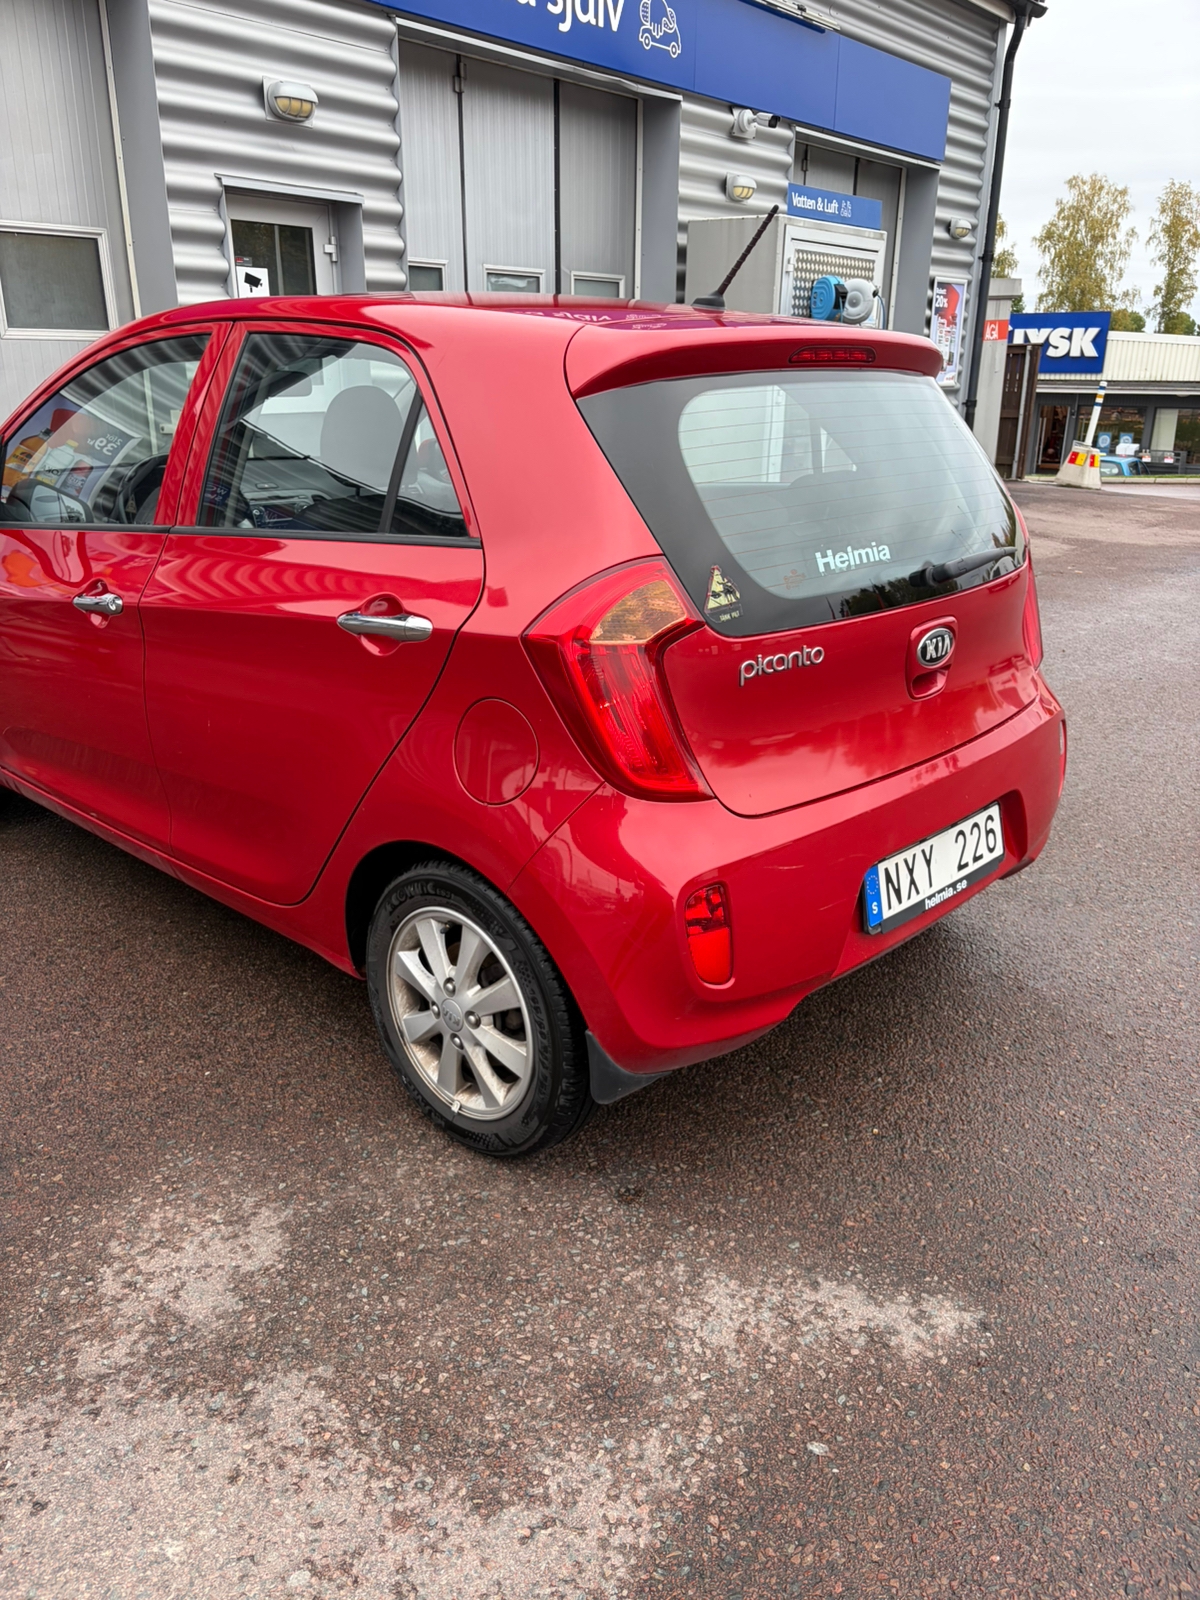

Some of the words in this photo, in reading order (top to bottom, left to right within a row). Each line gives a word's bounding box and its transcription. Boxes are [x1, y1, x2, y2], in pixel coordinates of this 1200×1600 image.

[791, 192, 816, 210] Vatten
[817, 197, 823, 211] &
[824, 199, 839, 214] Luft
[985, 321, 998, 340] AGA
[815, 541, 892, 574] Helmia
[925, 634, 951, 660] KIA
[740, 645, 824, 687] picanto
[884, 844, 934, 910] NXY
[955, 814, 997, 872] 226
[871, 902, 878, 914] S
[925, 879, 967, 909] helmia.se
